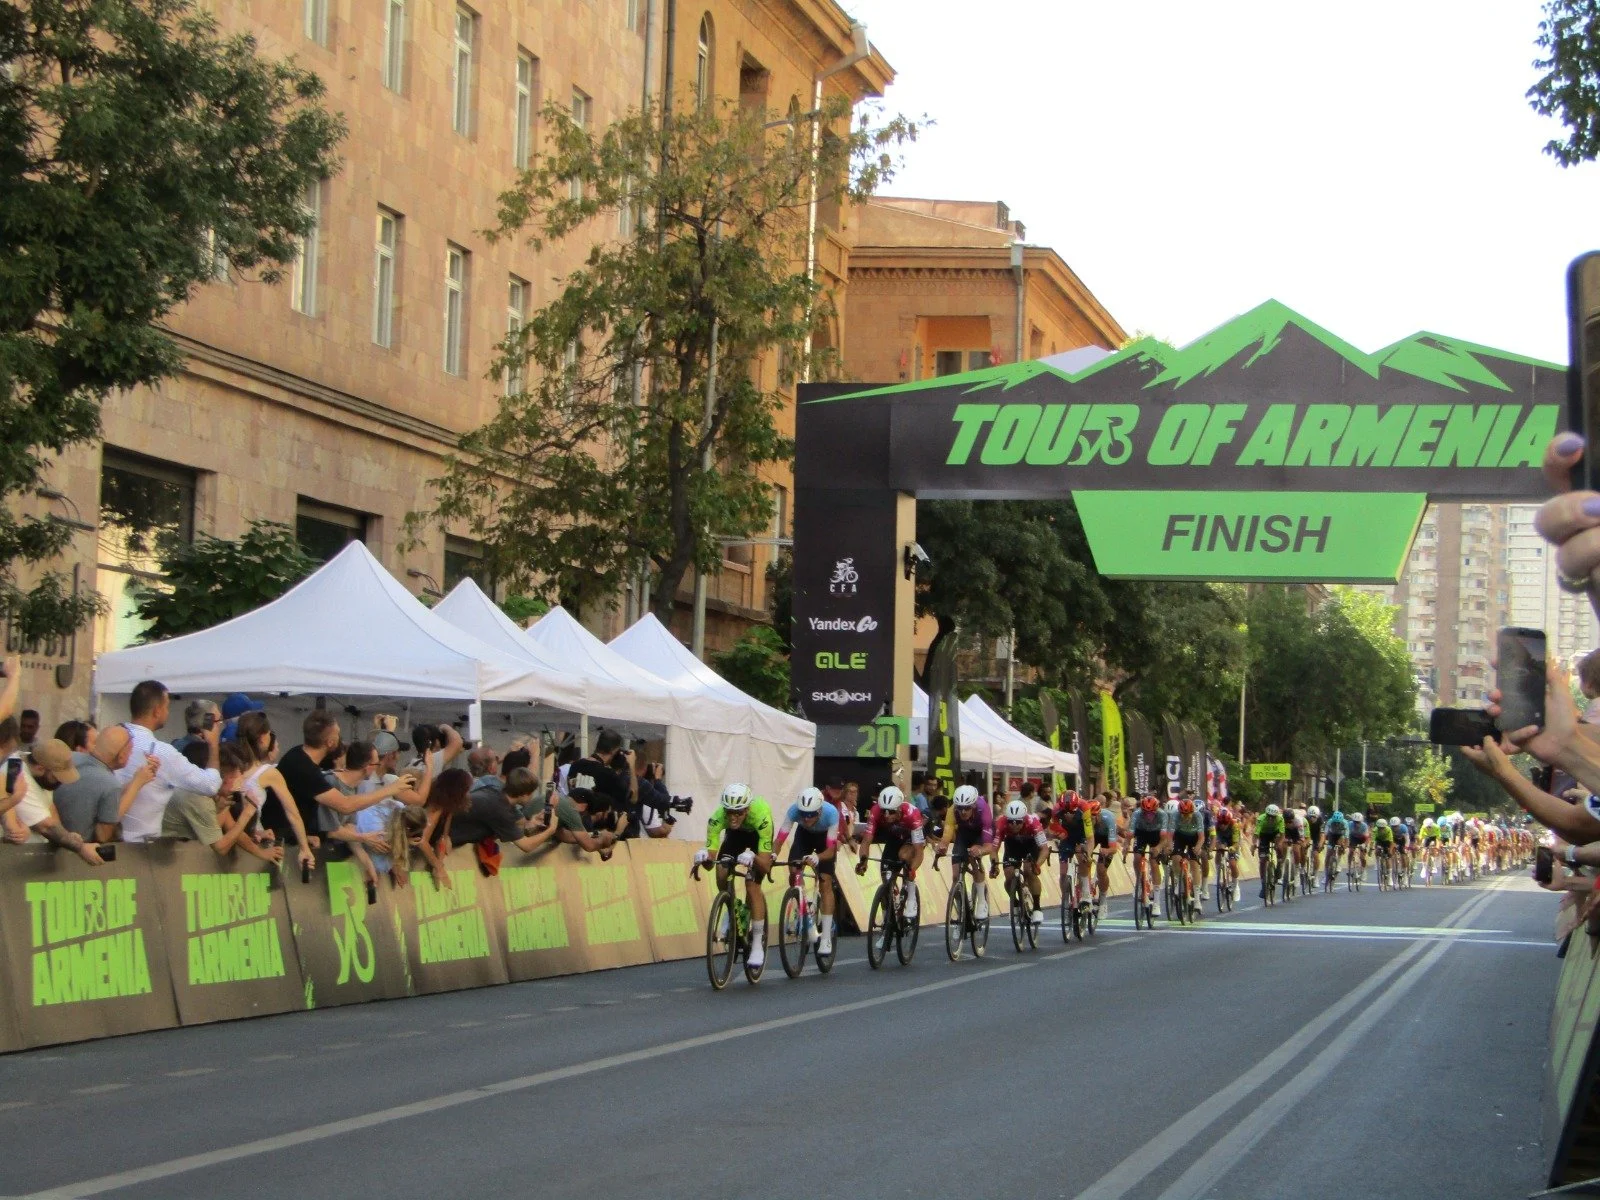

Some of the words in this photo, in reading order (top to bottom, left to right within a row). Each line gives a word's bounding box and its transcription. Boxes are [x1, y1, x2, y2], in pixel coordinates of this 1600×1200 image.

[946, 404, 1140, 465] TOUR
[1147, 404, 1248, 465] OF
[1234, 404, 1559, 467] ARMENIA
[1161, 514, 1332, 553] FINISH
[809, 617, 856, 631] Yandex
[857, 616, 878, 633] Go
[26, 880, 106, 947] TOUR
[106, 879, 137, 930] OF
[182, 874, 247, 932] TOUR
[507, 901, 569, 952] ARMENIA
[188, 917, 286, 985] ARMENIA
[418, 908, 490, 964] ARMENIA
[32, 928, 152, 1006] ARMENIA
